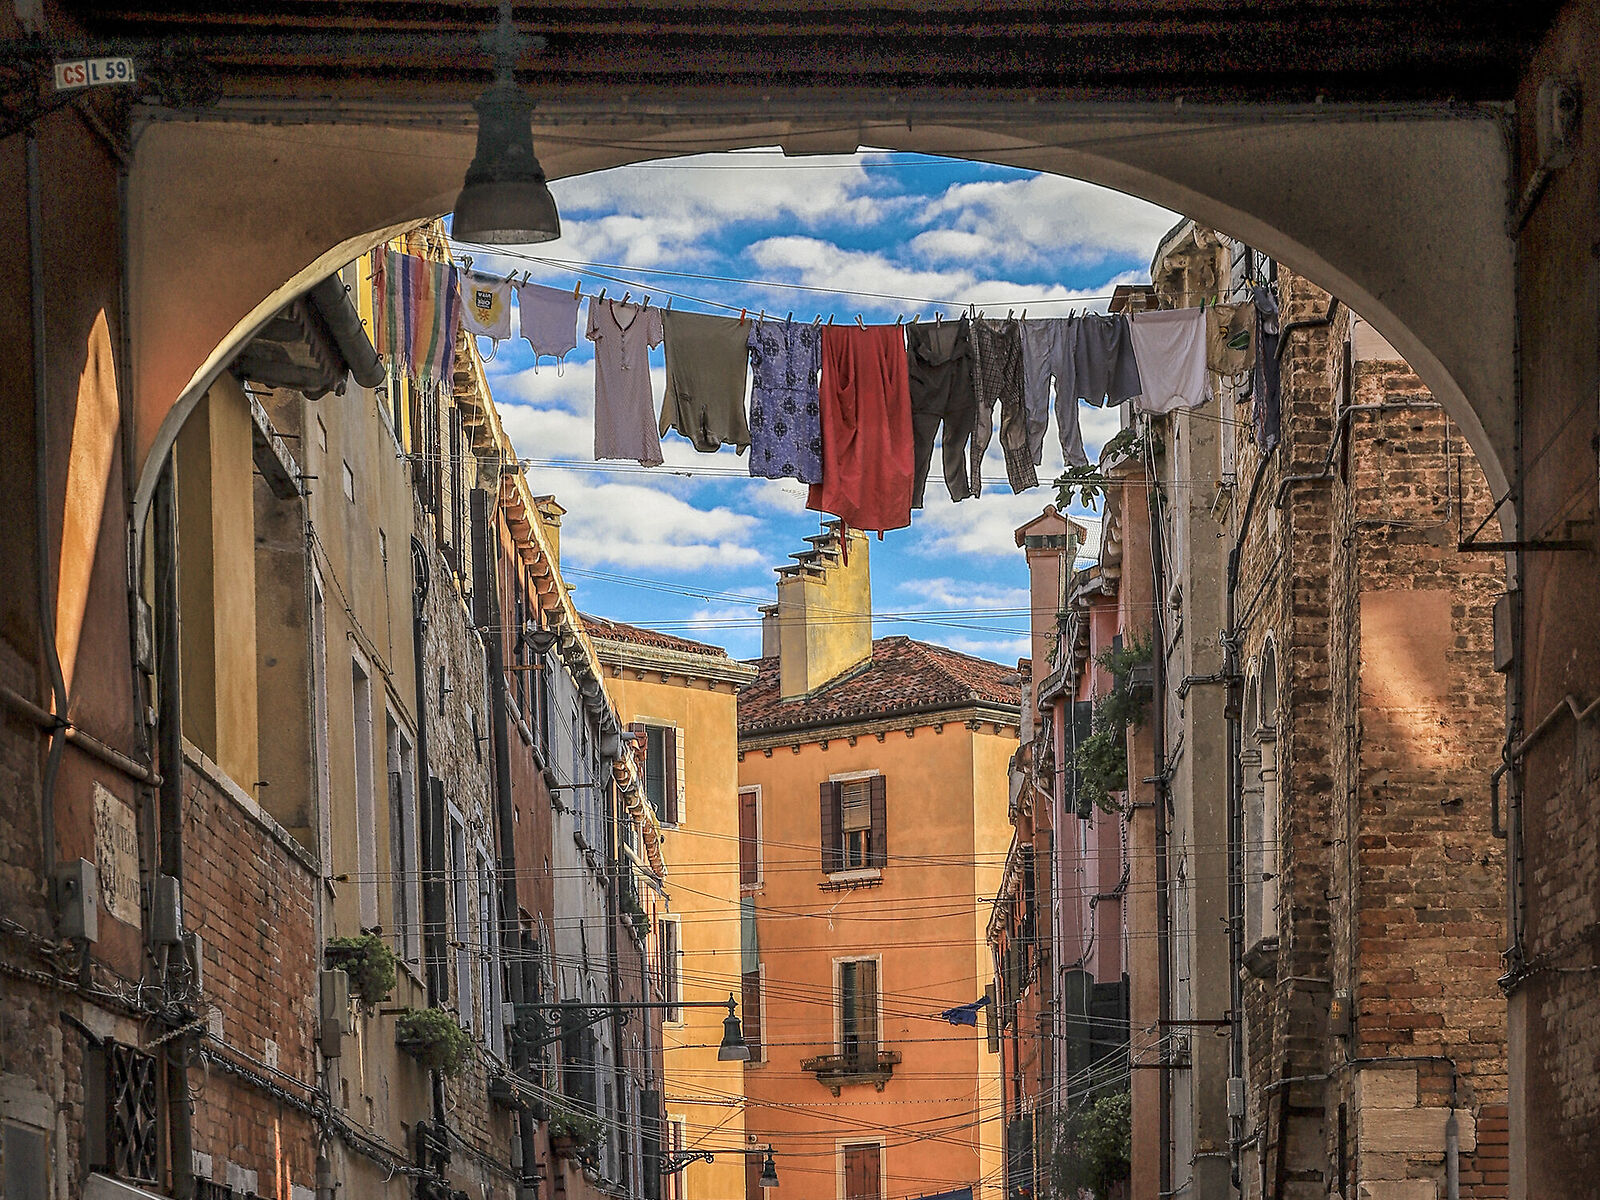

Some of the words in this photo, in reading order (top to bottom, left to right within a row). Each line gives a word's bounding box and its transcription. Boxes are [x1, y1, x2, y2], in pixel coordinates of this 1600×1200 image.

[64, 65, 85, 84] CS
[91, 63, 100, 81] L
[105, 61, 127, 80] 59
